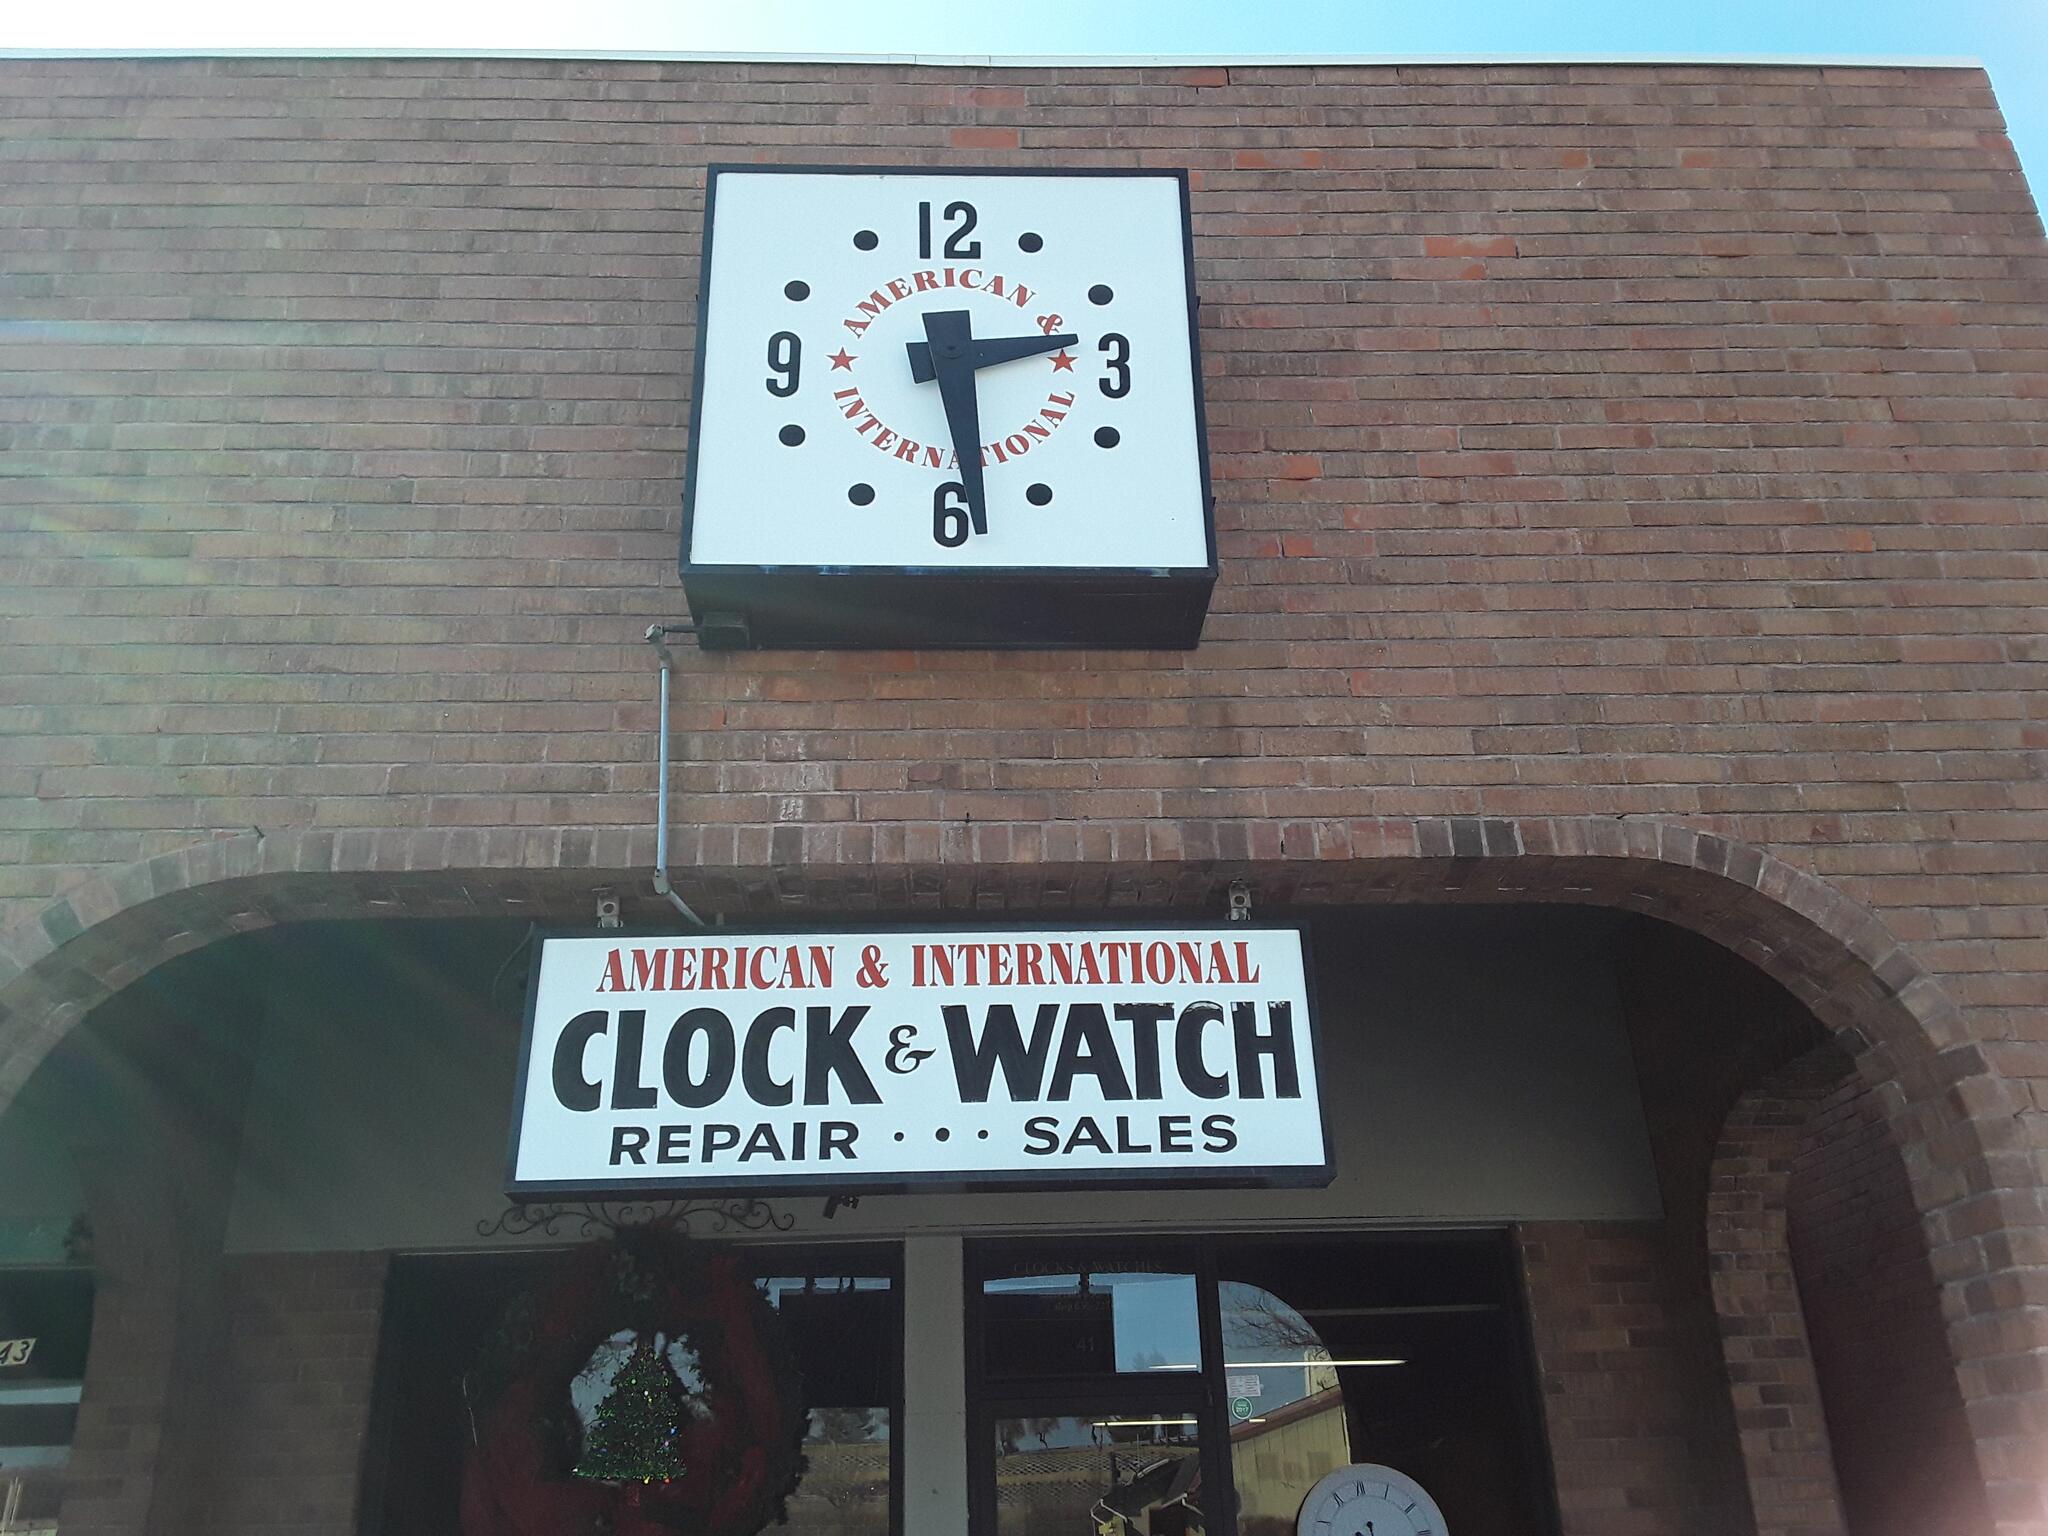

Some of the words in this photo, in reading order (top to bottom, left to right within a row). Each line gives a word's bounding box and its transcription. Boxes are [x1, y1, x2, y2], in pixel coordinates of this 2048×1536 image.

[919, 201, 982, 260] 12
[843, 267, 1037, 339] AMERICAN
[766, 331, 801, 398] 9
[1098, 332, 1131, 399] 3
[932, 481, 969, 548] 6
[596, 945, 835, 992] AMERICAN
[856, 944, 889, 988] &
[911, 940, 1260, 987] INTERNATIONAL
[552, 1005, 884, 1112] CLOCK
[885, 1024, 937, 1074] &
[941, 1000, 1302, 1104] WATCH
[608, 1121, 860, 1165] REPAIR
[1023, 1114, 1238, 1155] SALES
